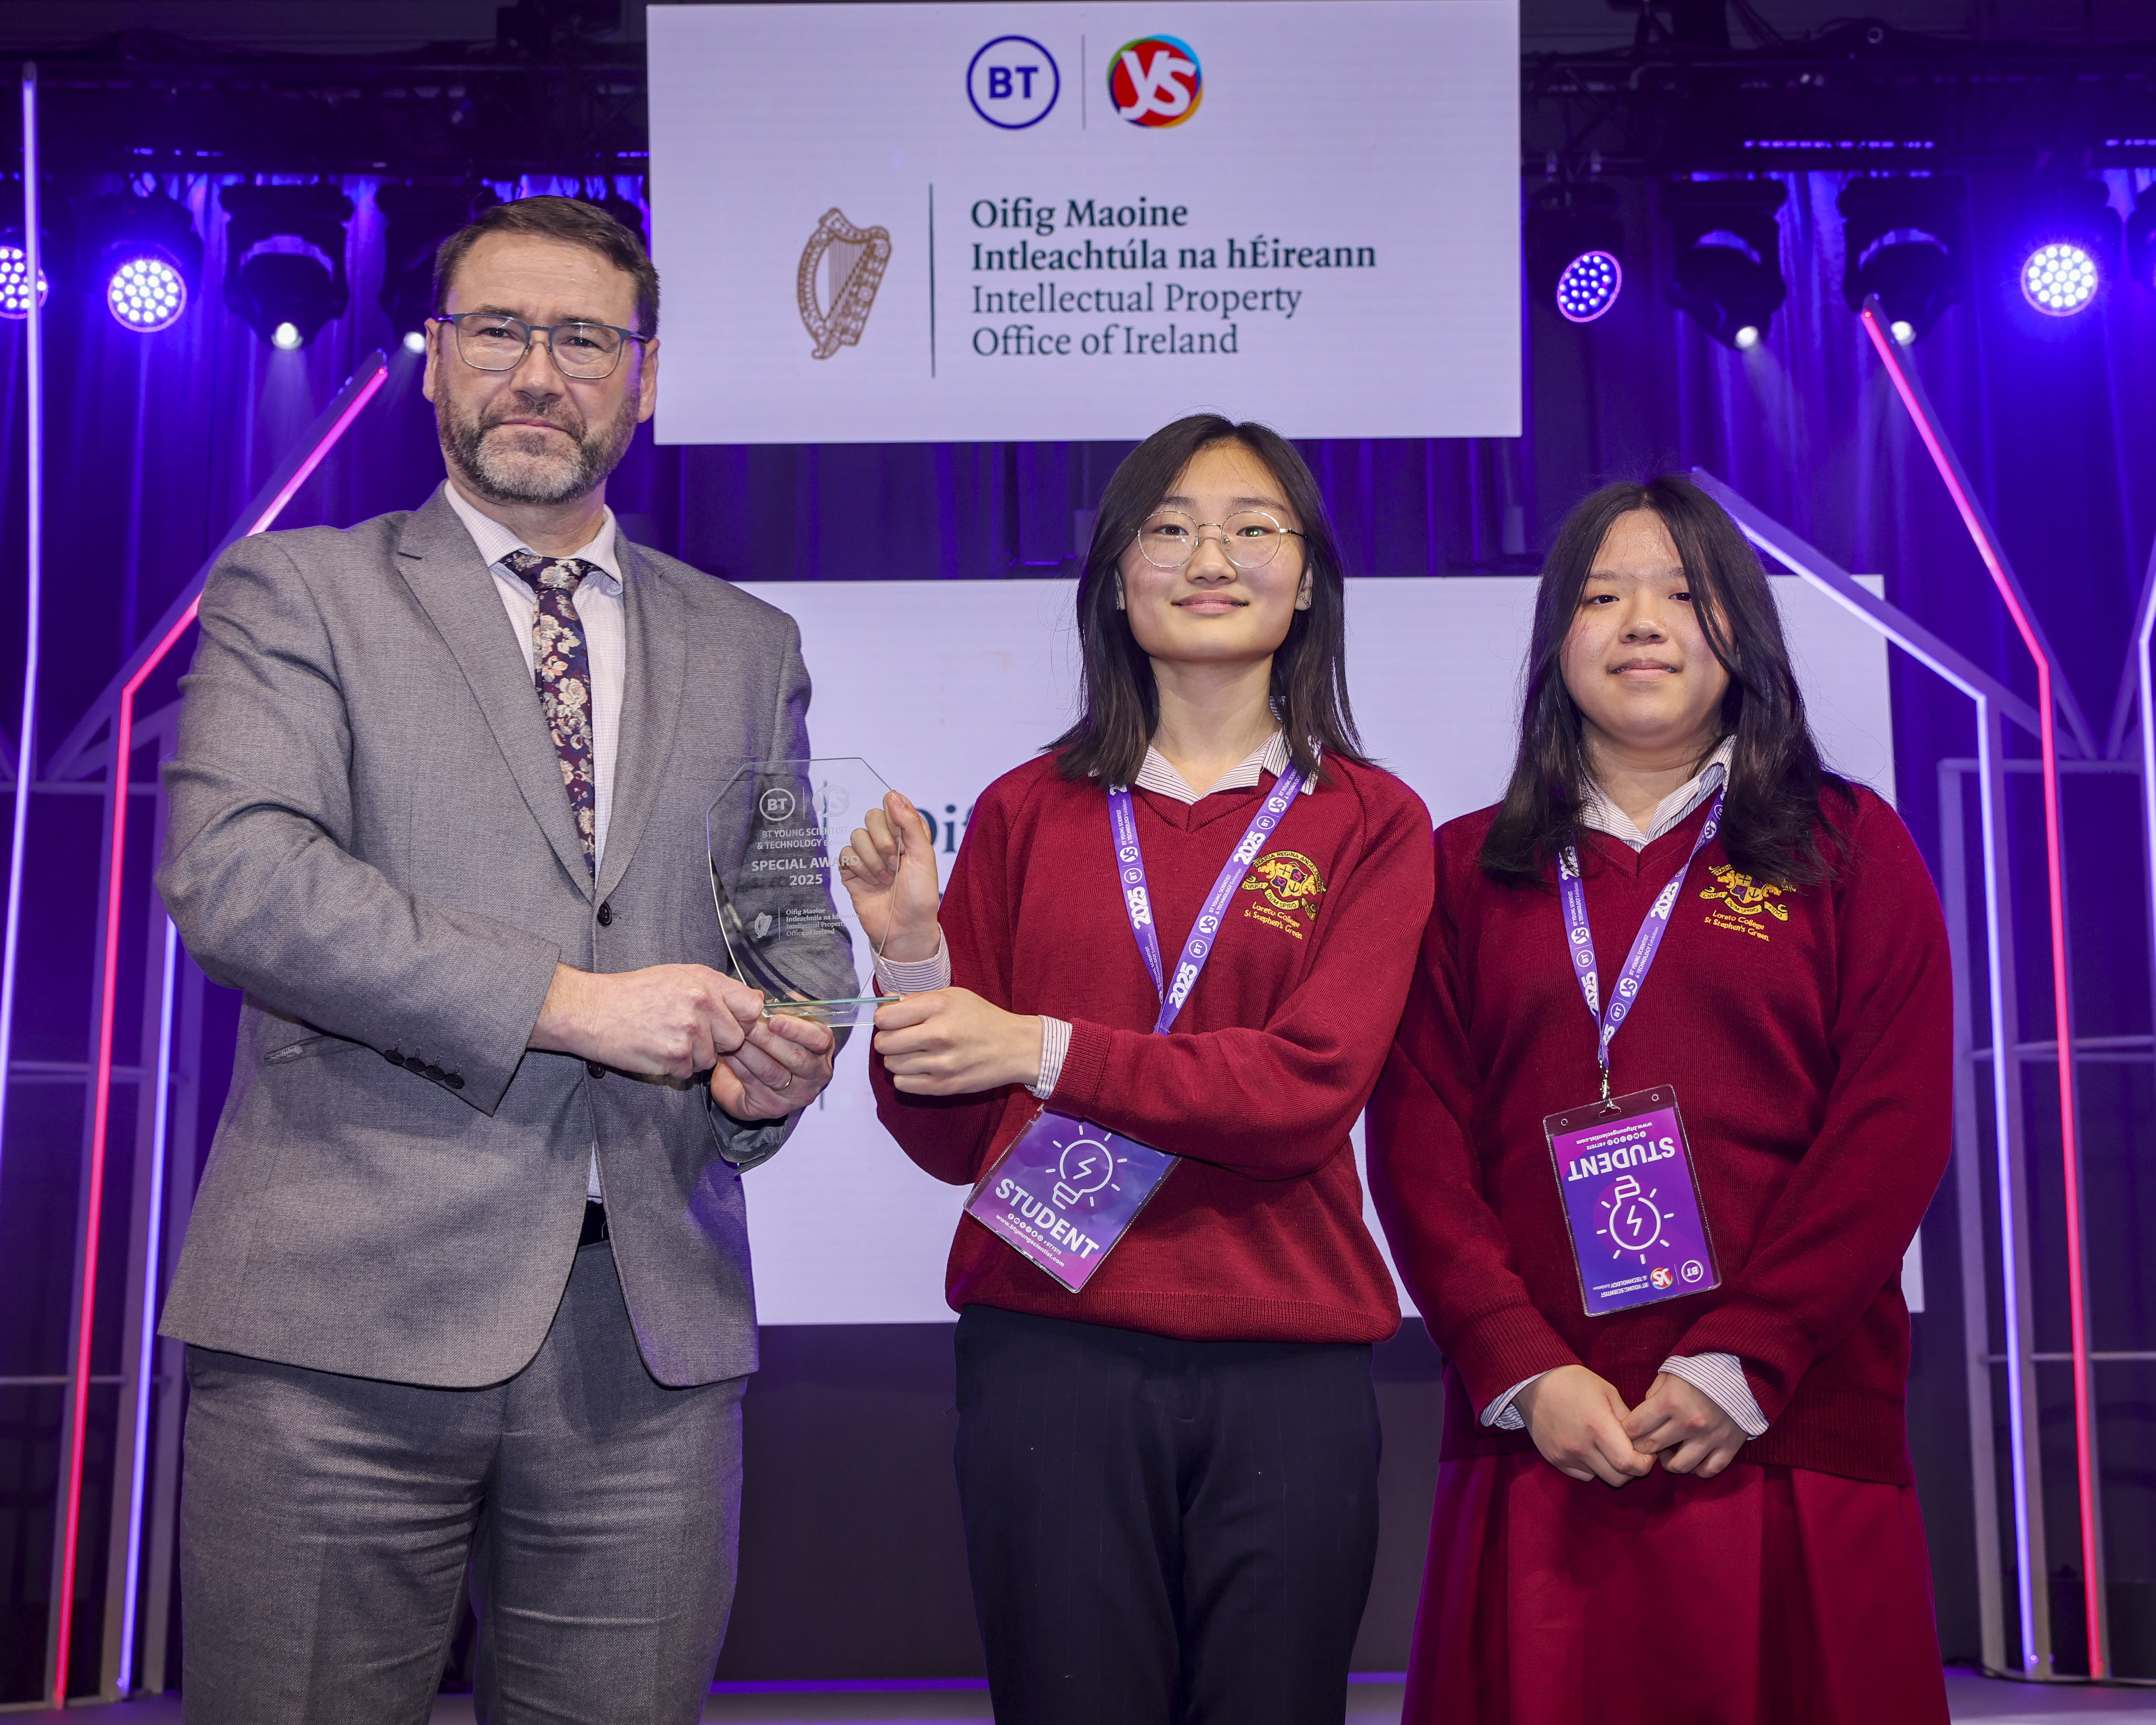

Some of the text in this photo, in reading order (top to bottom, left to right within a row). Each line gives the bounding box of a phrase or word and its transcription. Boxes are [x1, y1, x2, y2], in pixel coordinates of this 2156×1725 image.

[988, 67, 1038, 99] BT
[971, 197, 1188, 236] Oifig Maoine
[972, 235, 1376, 270] Intleachtúla na hÉireann
[972, 283, 1302, 319] Intellectual Property
[973, 324, 1238, 356] Office of Ireland
[1281, 779, 1292, 792] YOUNG
[768, 798, 787, 811] BT
[772, 828, 804, 838] YOUNG
[806, 826, 848, 836] SCIENTIST
[1124, 816, 1132, 840] TECHNOLOGY
[1261, 818, 1271, 827] BT
[765, 838, 822, 849] TECHNOLOGY
[1233, 831, 1266, 865] 2025
[751, 856, 860, 871] SPECIAL AWARD
[1254, 854, 1275, 867] MARIA
[790, 874, 823, 886] 2025
[1129, 871, 1137, 880] BT
[1211, 893, 1222, 907] YOUNG
[1219, 874, 1231, 893] SCIENTIST
[1217, 884, 1232, 910] TECHNOLOGY
[1230, 868, 1242, 885] Exhibition
[1266, 892, 1278, 905] DUM
[1127, 886, 1151, 930] 2025
[1650, 881, 1680, 920] 2025
[1727, 901, 1739, 911] DUM
[1768, 905, 1782, 918] FIDO
[1252, 901, 1300, 927] Loreto College
[1253, 911, 1283, 929] Stephen's
[1712, 910, 1764, 930] Loreto College
[1145, 946, 1154, 968] SCIENTIST
[1193, 943, 1203, 954] BT
[1632, 955, 1641, 970] YOUNG
[1637, 934, 1649, 956] SCIENTIST
[1637, 946, 1651, 974] TECHNOLOGY
[1648, 927, 1659, 946] Exhibition
[1582, 954, 1589, 964] BT
[1169, 962, 1198, 1009] 2025
[1581, 971, 1598, 1017] 2025
[1614, 1006, 1622, 1018] BT
[1576, 1122, 1652, 1144] www.btyoungscientist.com
[1586, 1141, 1606, 1150] #BTYSTE
[1568, 1137, 1676, 1182] STUDENT
[995, 1178, 1100, 1259] STUDENT
[996, 1214, 1065, 1267] www.btyoungscientist.com
[1043, 1240, 1061, 1255] #BTYSTE
[1687, 1266, 1699, 1276] BT
[1611, 1276, 1643, 1288] TECHNOLOGY
[1624, 1284, 1641, 1292] YOUNG
[1601, 1288, 1625, 1297] SCIENTIST
